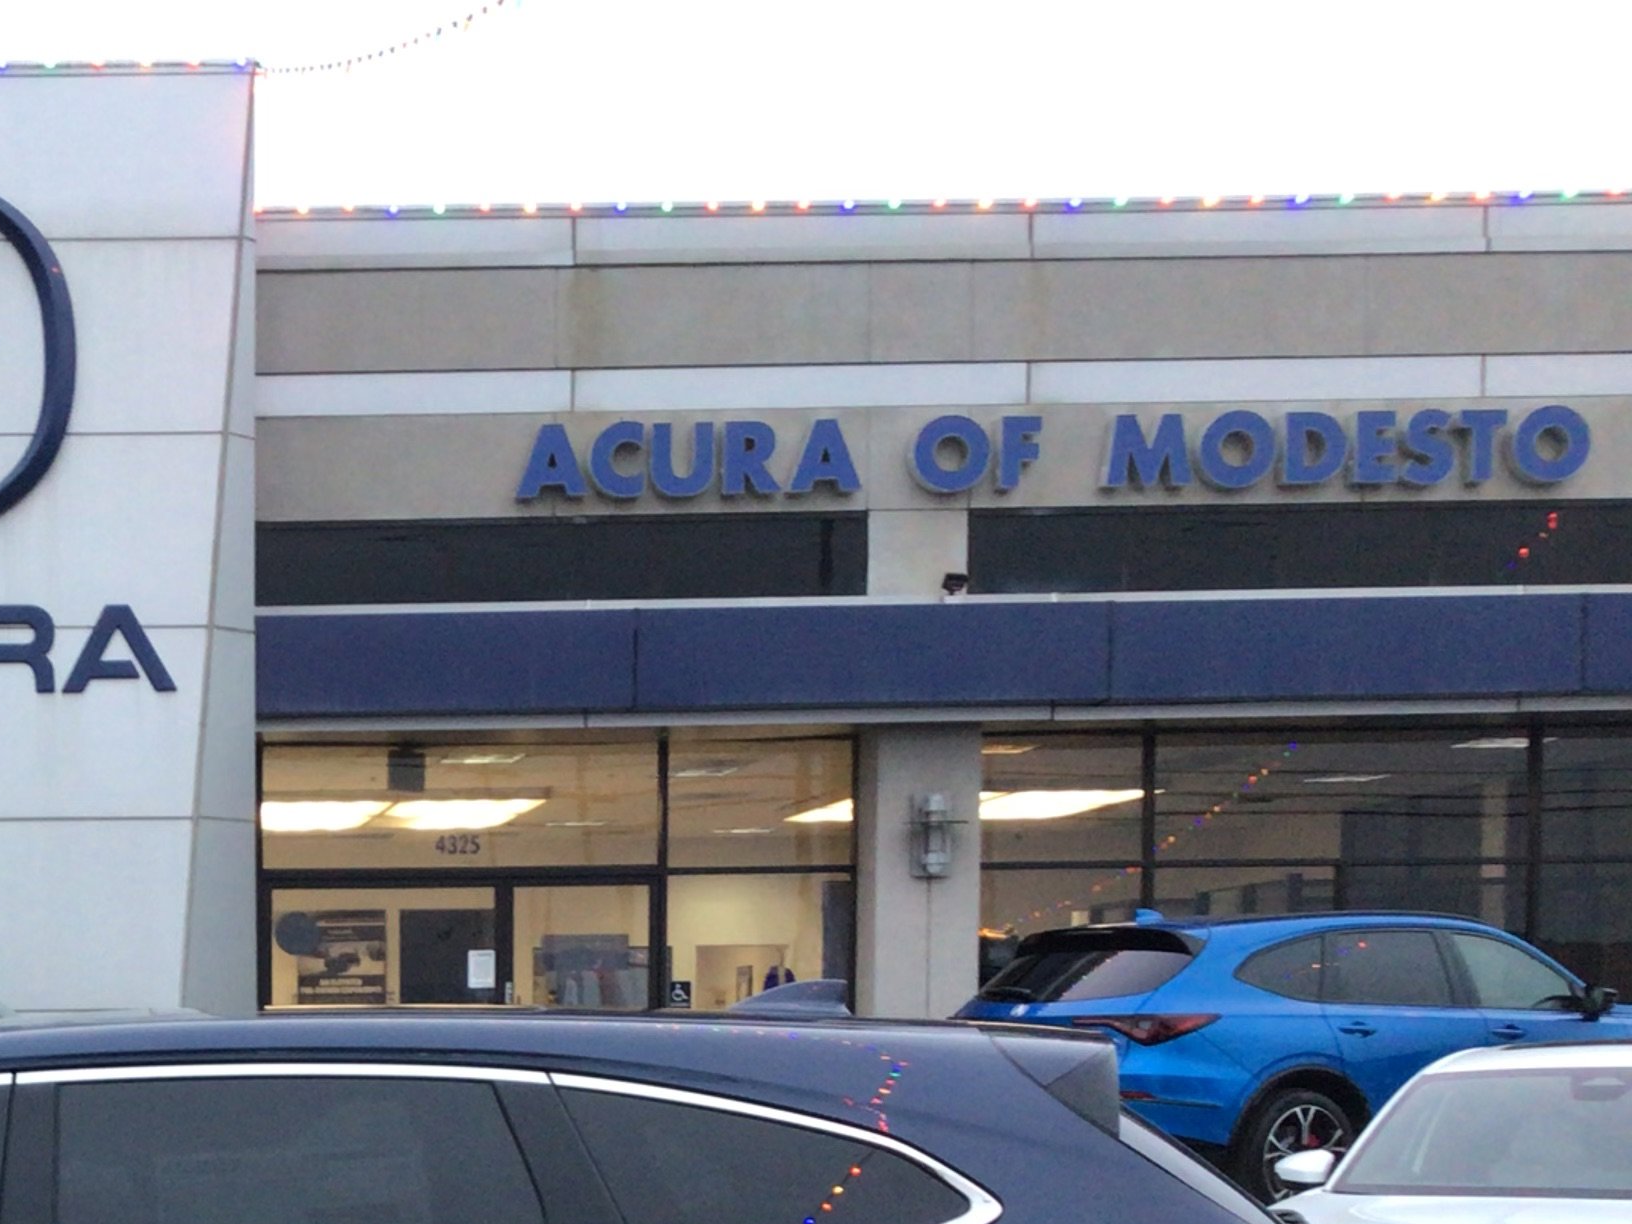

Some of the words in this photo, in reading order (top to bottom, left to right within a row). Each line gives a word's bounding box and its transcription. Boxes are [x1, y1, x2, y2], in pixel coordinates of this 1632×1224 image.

[515, 418, 863, 498] ACURA
[912, 414, 1043, 494] OF
[1106, 404, 1591, 490] MODESTO
[435, 834, 481, 855] 4325
